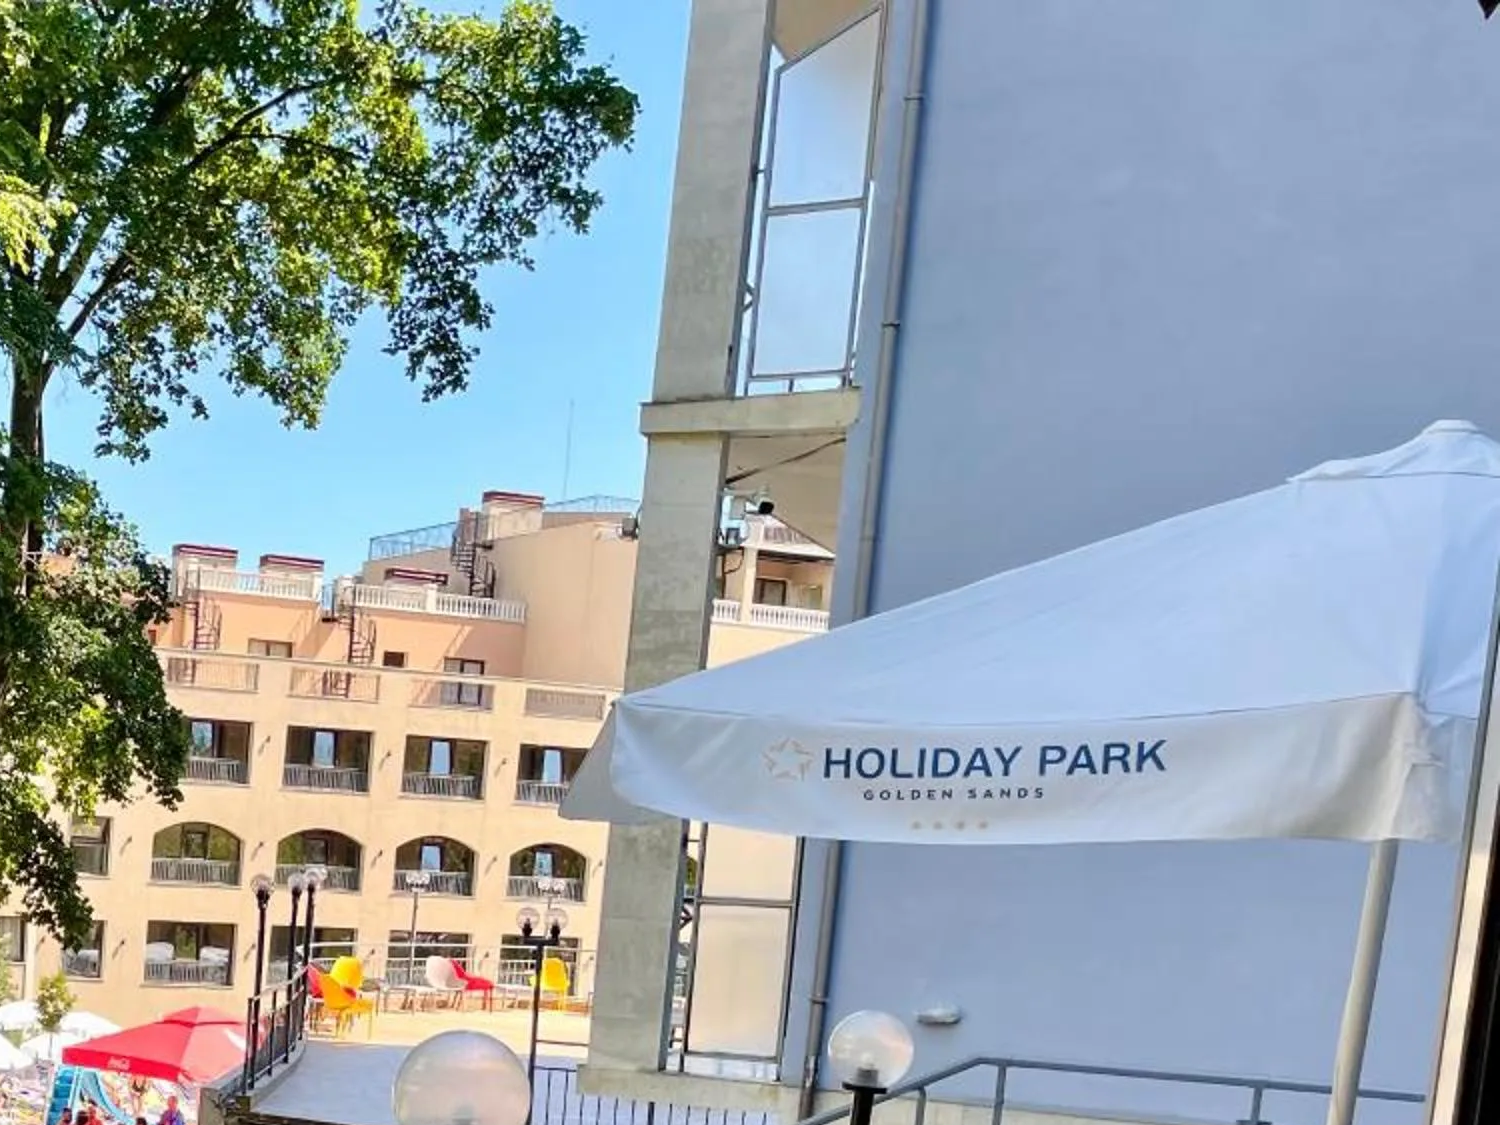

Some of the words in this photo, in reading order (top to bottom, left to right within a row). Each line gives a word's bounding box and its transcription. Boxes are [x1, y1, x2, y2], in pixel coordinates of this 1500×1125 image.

[822, 746, 1023, 780] HOLIDAY
[1038, 739, 1168, 777] PARK
[863, 788, 954, 801] GOLDEN
[967, 787, 1044, 800] SANDS
